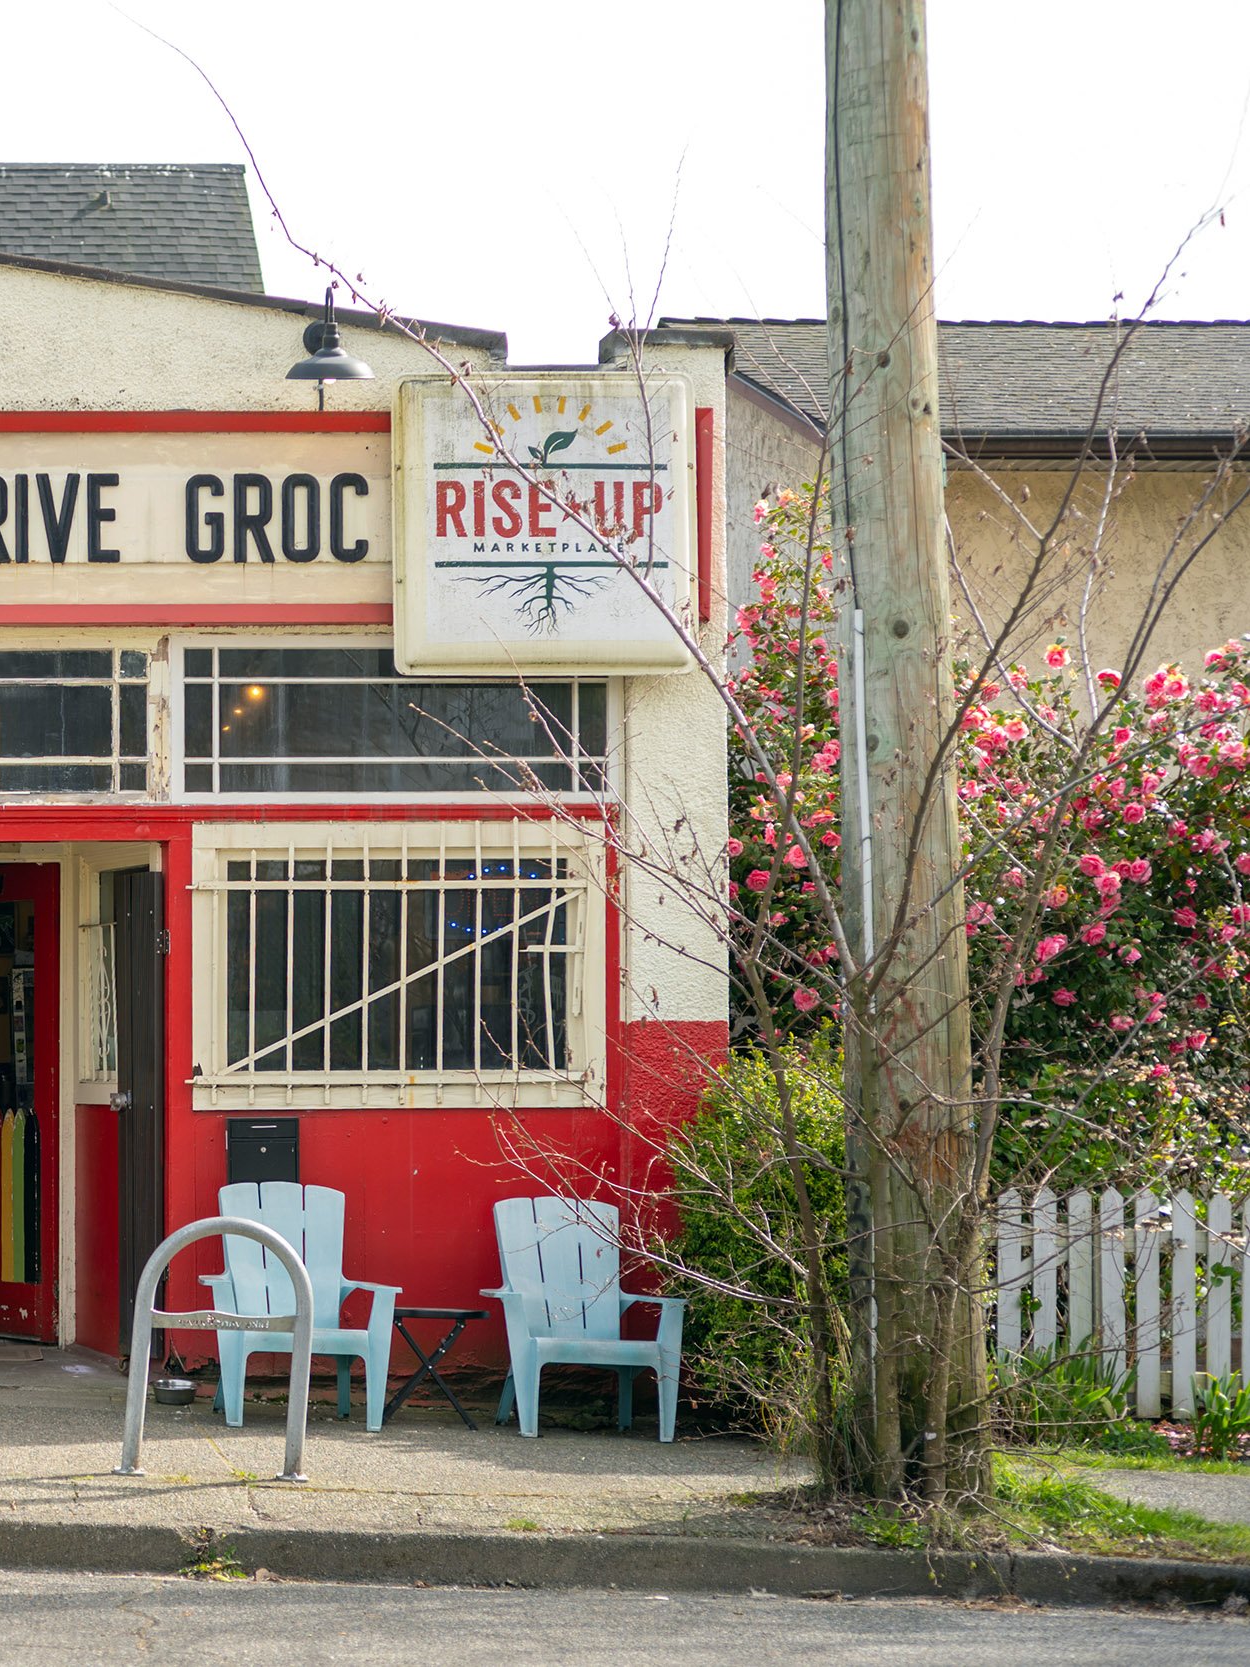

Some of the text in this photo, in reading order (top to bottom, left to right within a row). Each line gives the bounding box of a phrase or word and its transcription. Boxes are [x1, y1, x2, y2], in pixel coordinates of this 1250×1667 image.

[185, 473, 369, 565] GROC
[436, 479, 663, 539] RISE UP
[473, 542, 626, 554] MARKETPLACE
